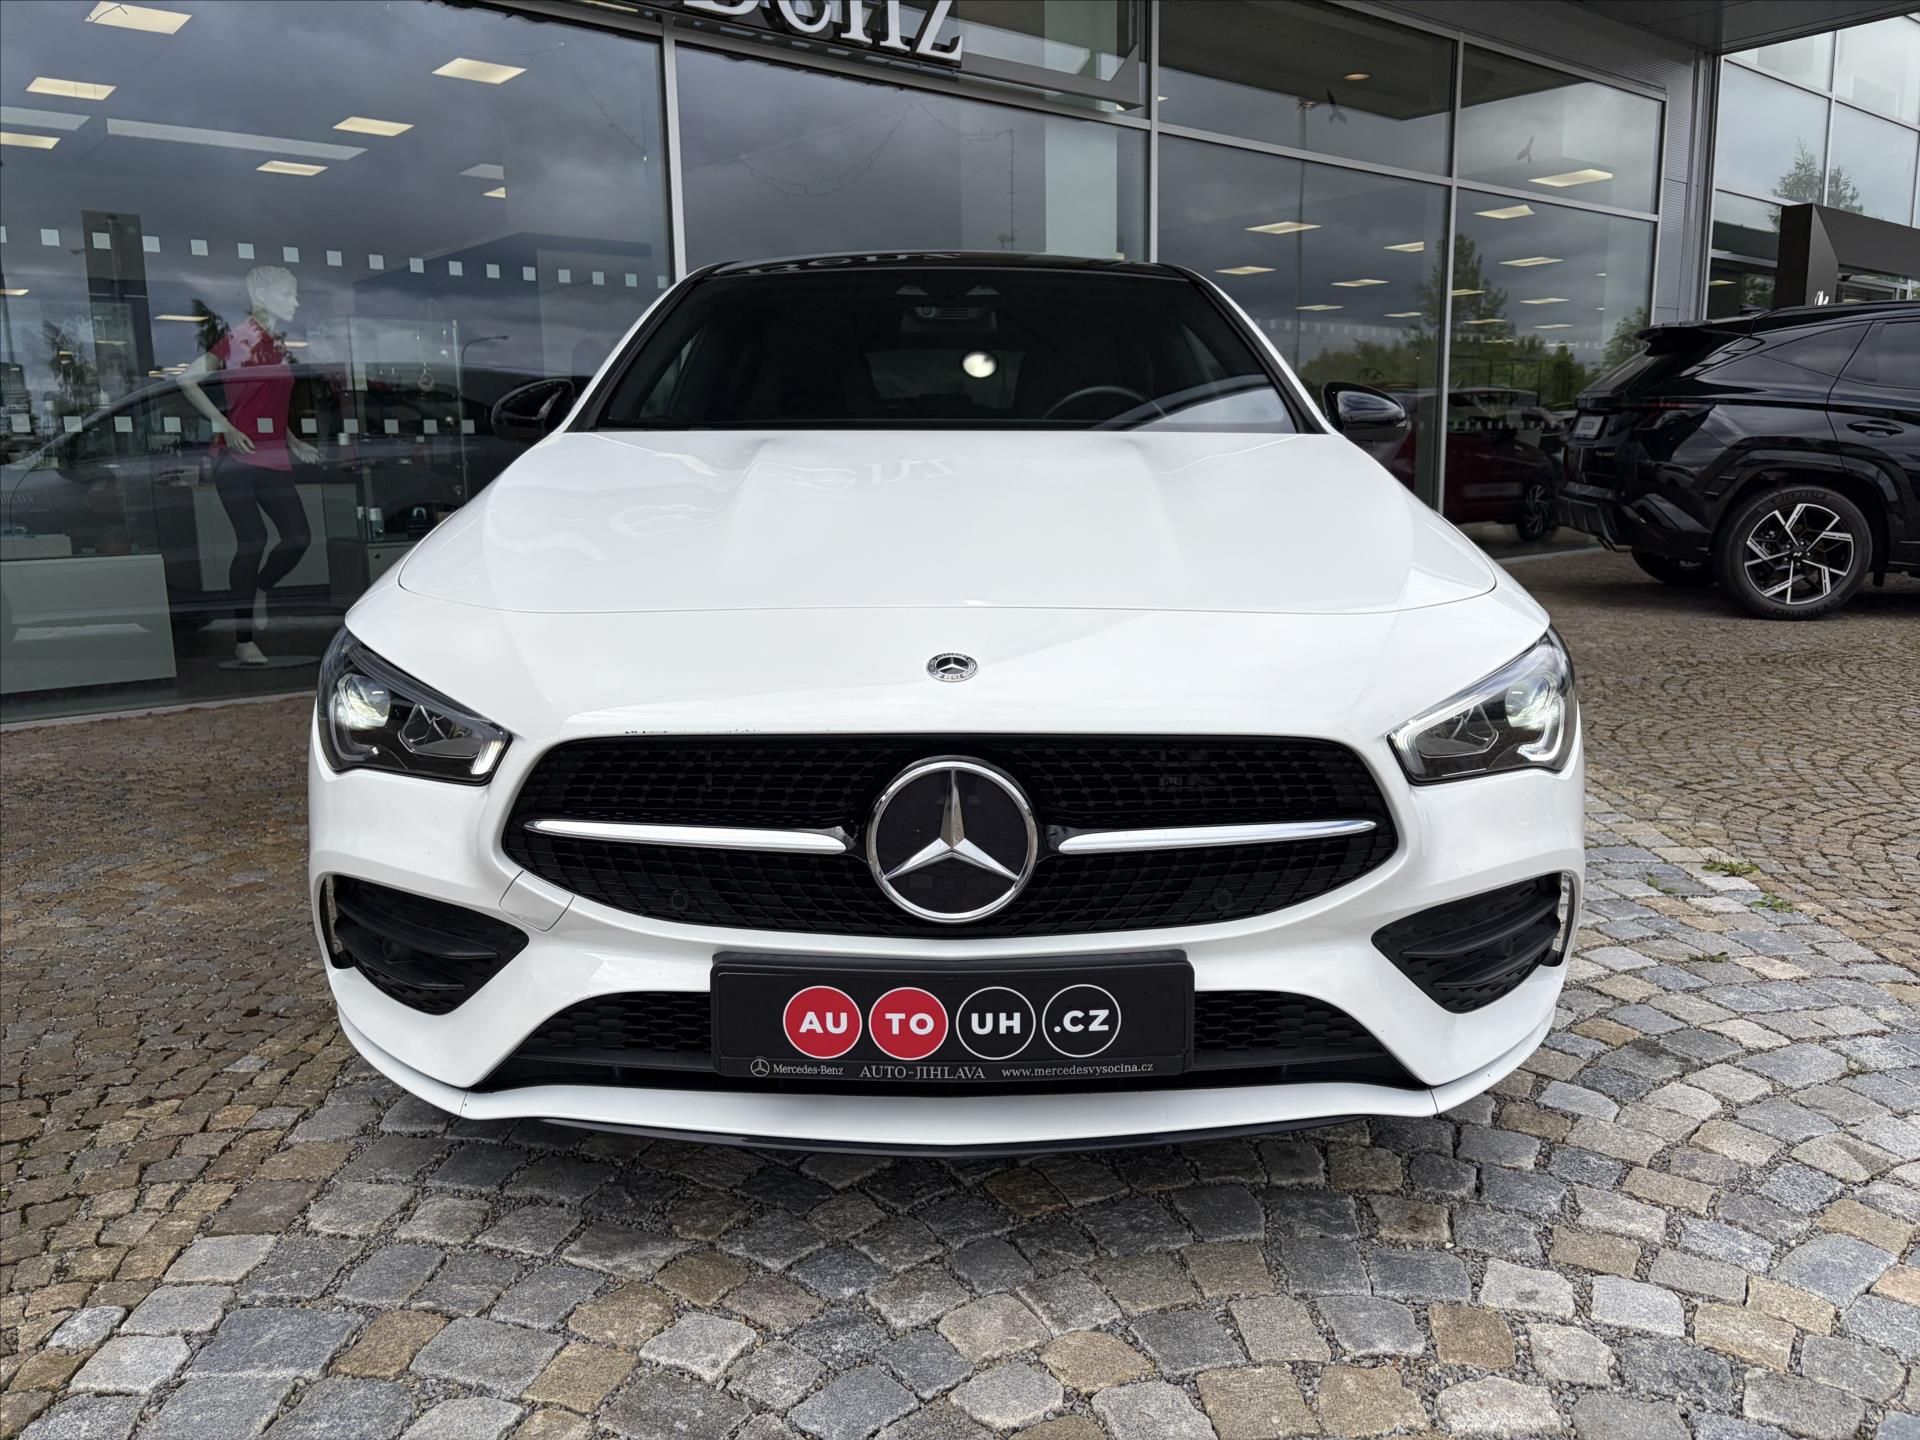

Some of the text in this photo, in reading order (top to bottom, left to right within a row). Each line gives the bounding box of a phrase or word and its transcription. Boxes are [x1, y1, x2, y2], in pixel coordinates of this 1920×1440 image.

[799, 1009, 1110, 1035] AU TO UH .CZ
[773, 1063, 1154, 1079] Mercedes-Benz AUTO-JIHLAVA www.mercedesvysocina.cz
